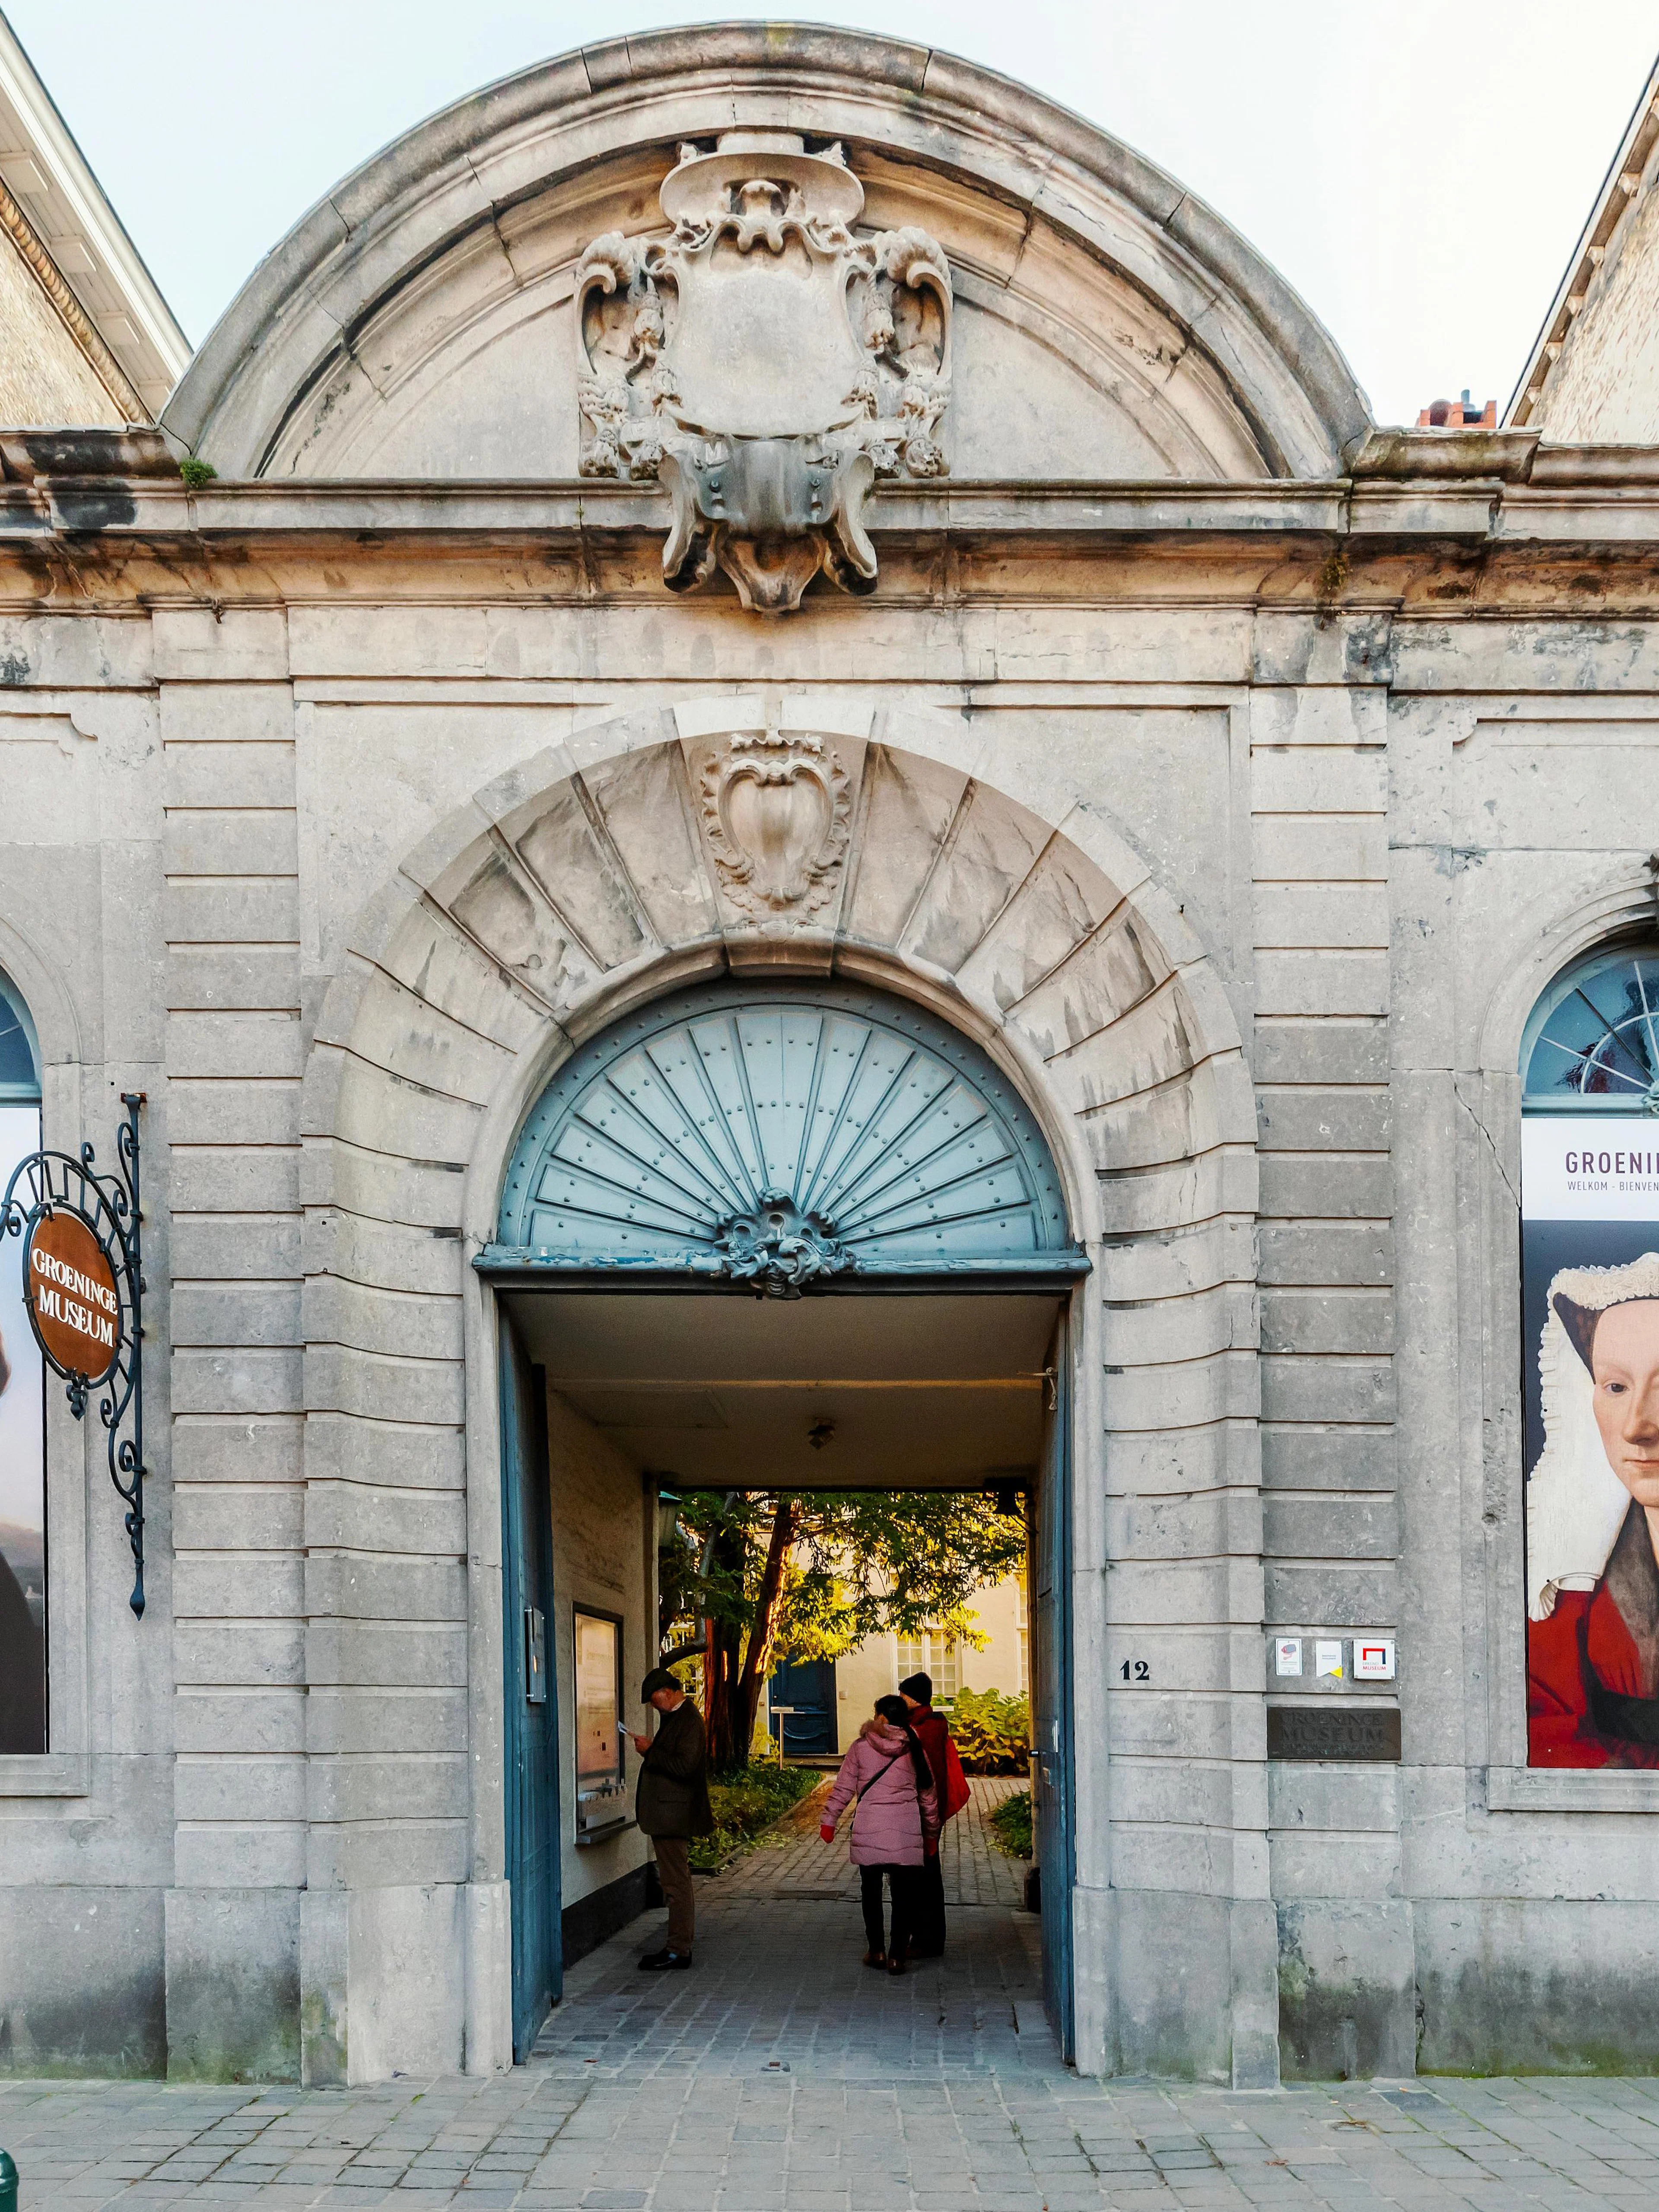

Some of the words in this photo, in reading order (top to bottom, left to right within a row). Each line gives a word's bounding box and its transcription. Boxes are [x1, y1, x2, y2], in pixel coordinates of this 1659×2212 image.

[1566, 1152, 1659, 1173] GROENI
[1567, 1181, 1607, 1191] WELKOM
[32, 1248, 118, 1315] GROENINGE
[39, 1284, 113, 1347] MUSEUM
[1120, 1660, 1150, 1680] 12
[1282, 1727, 1385, 1742] MUSEUM
